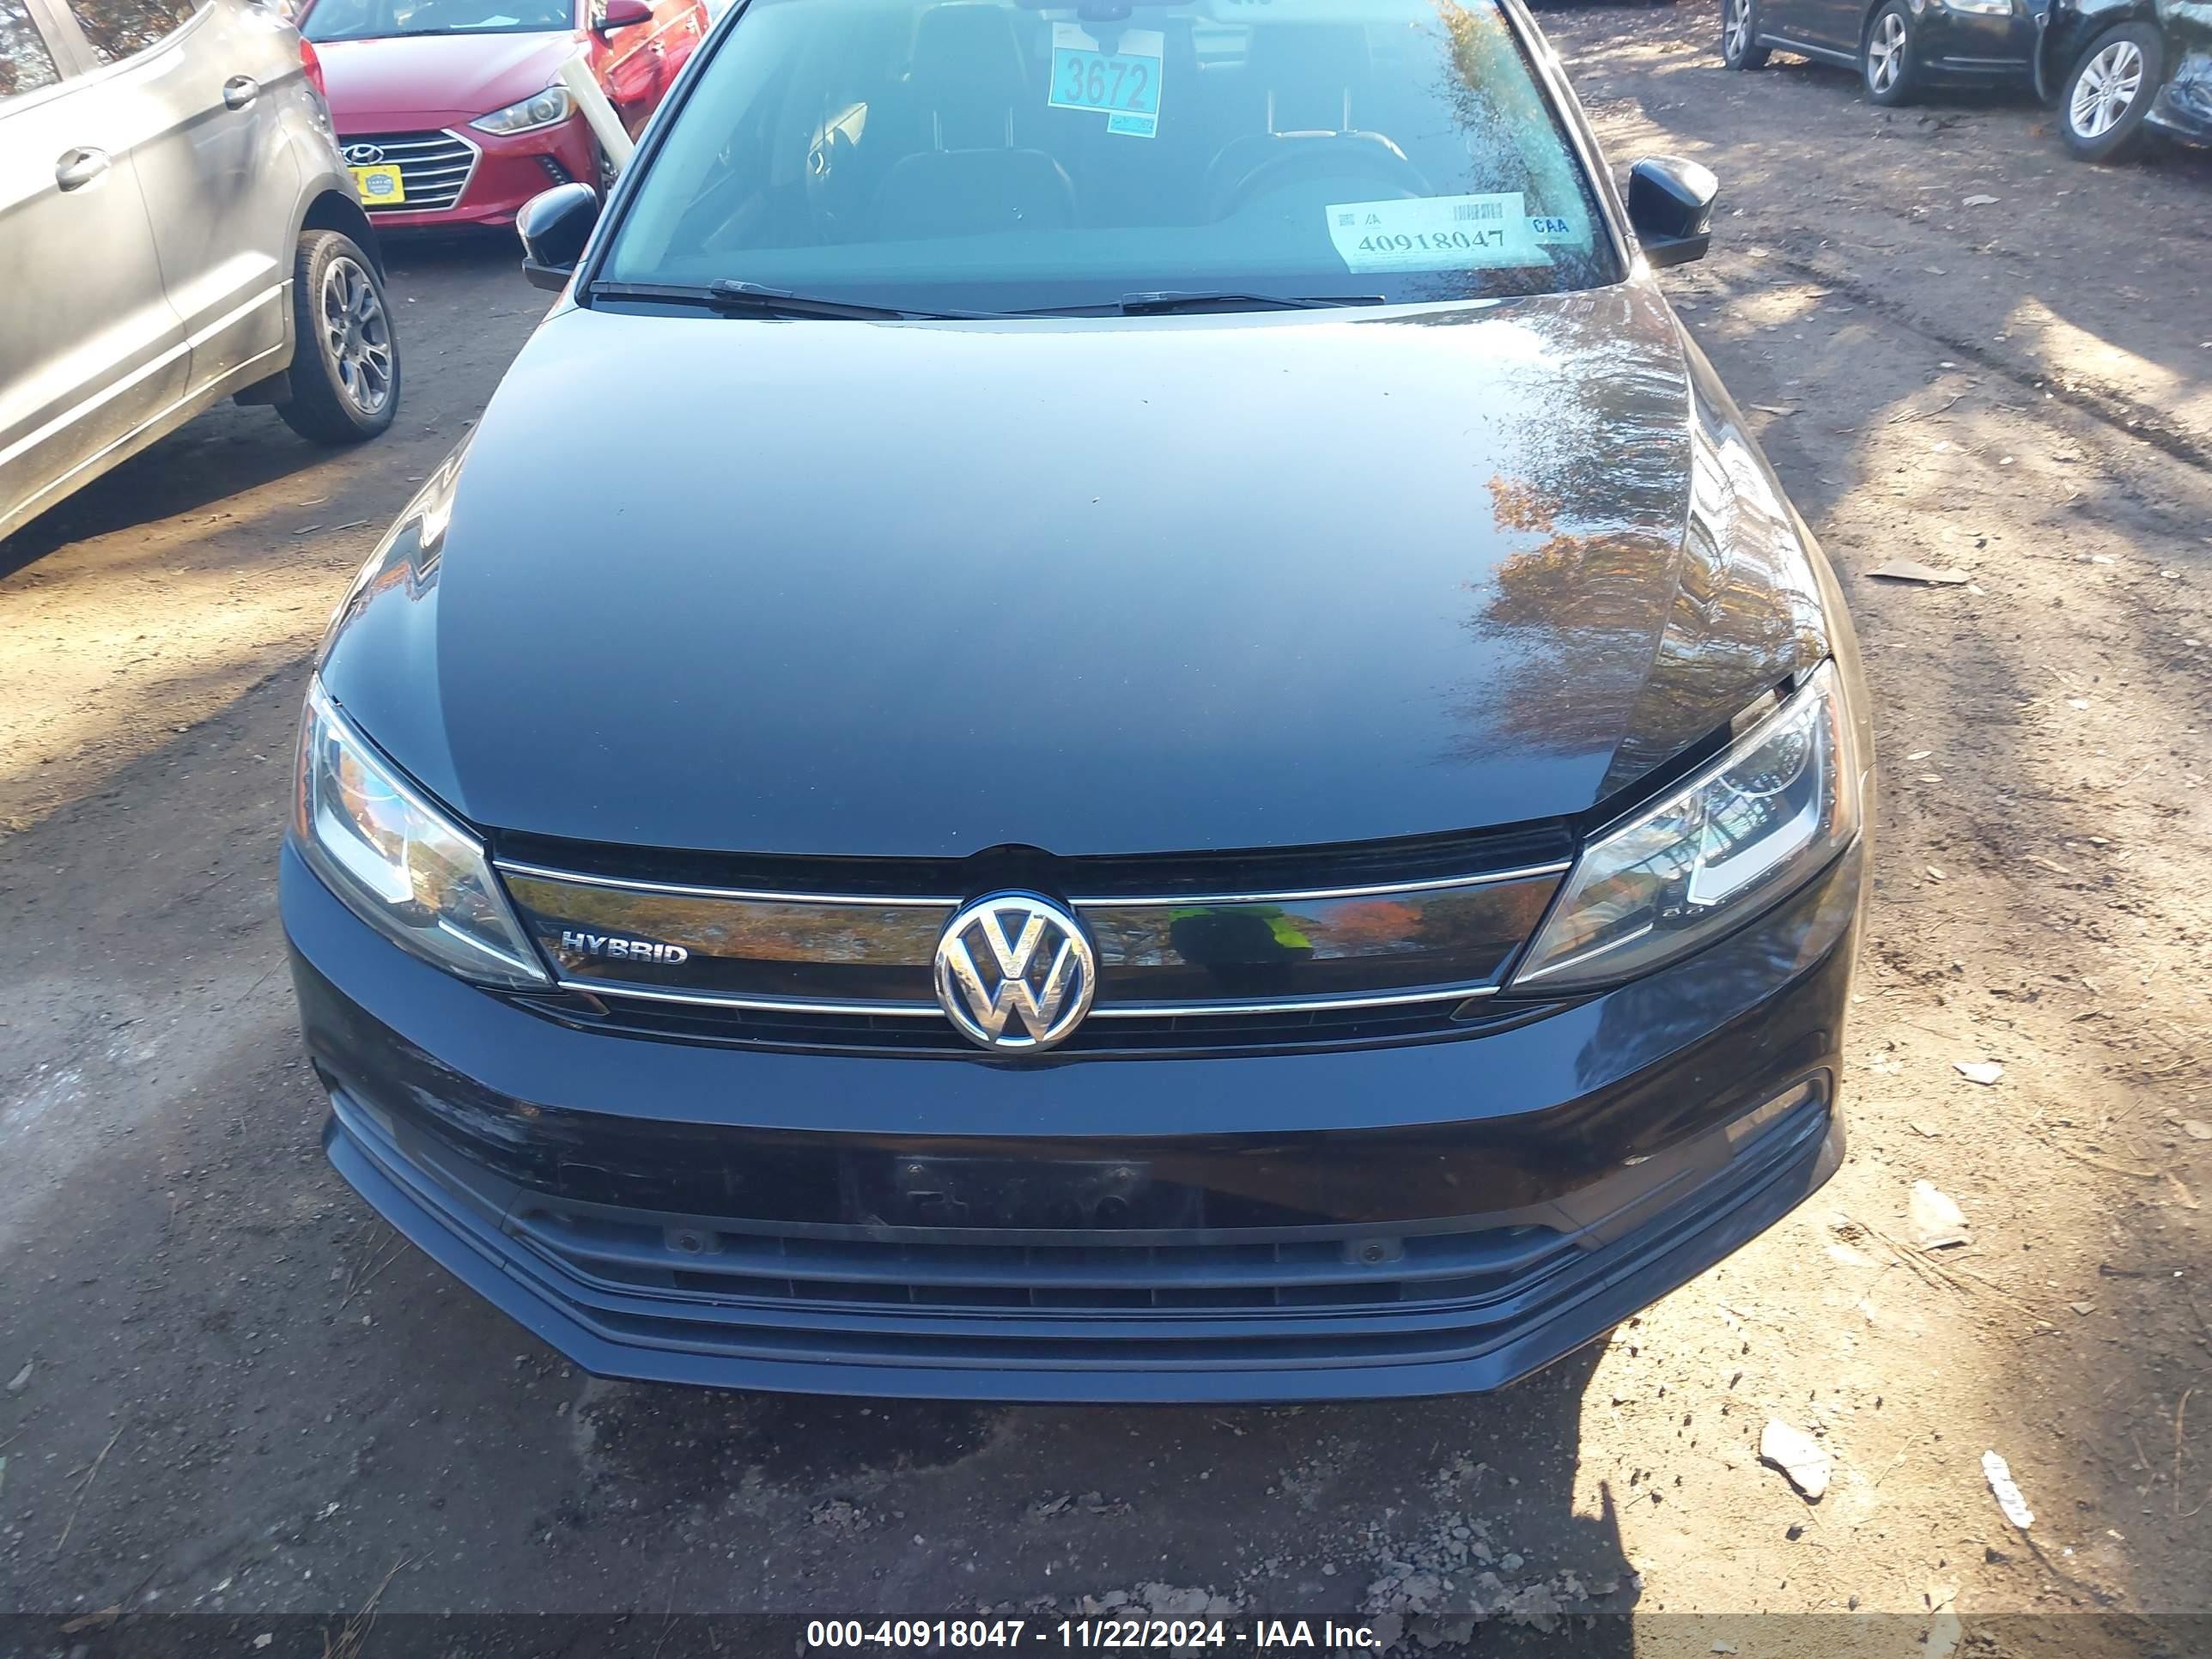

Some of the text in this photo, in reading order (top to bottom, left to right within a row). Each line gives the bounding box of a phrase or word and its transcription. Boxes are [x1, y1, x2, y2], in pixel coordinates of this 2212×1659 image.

[1065, 57, 1148, 108] 3672
[1533, 218, 1570, 234] CAA
[1358, 229, 1504, 252] 40918047
[562, 931, 688, 965] HYBRID
